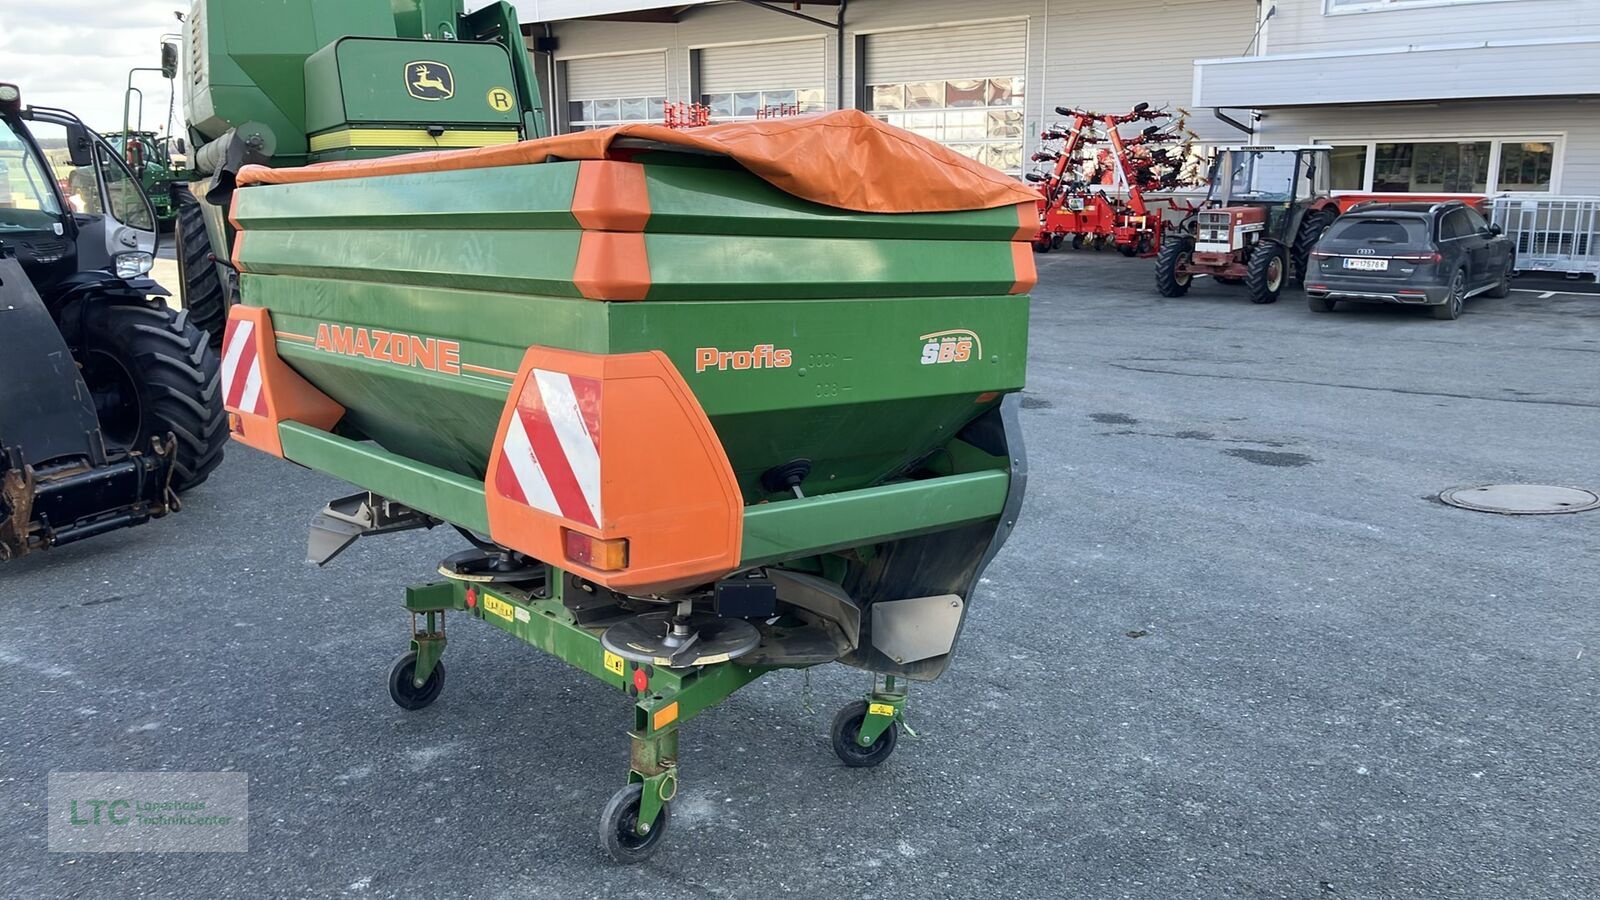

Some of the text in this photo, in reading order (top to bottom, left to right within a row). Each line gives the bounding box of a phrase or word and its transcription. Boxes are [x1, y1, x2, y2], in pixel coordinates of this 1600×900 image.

[493, 92, 508, 108] R
[315, 323, 460, 376] AMAZONE
[695, 344, 792, 373] Profis
[920, 340, 973, 365] SBS
